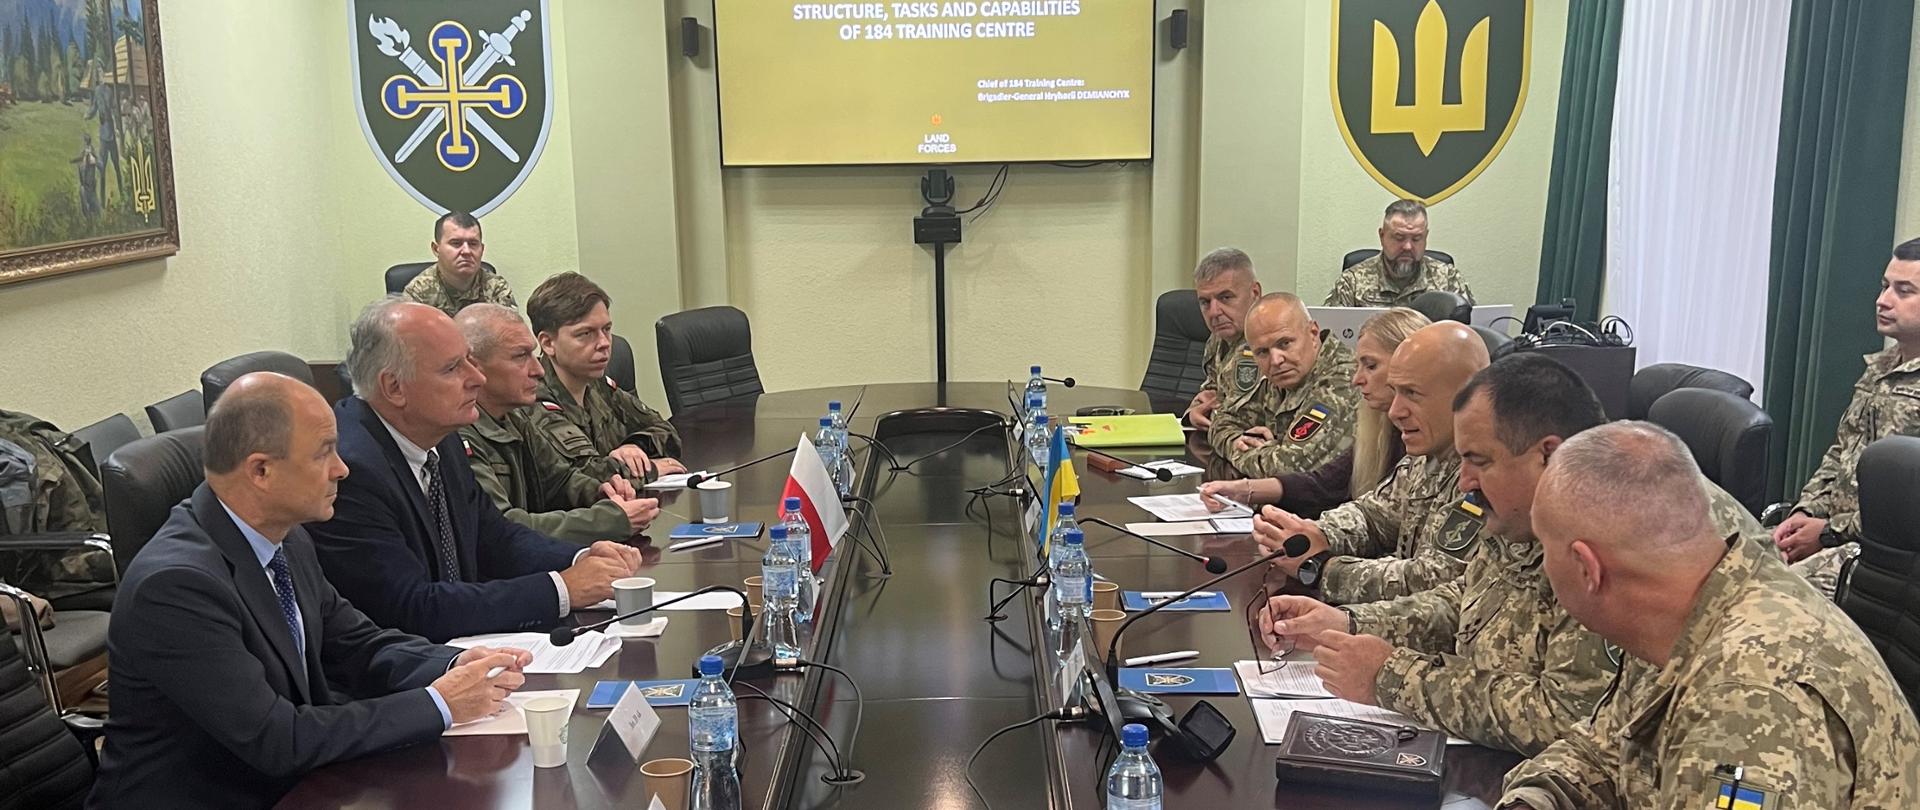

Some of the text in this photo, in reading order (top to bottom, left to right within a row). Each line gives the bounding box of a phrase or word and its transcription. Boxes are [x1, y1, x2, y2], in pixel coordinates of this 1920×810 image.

[793, 0, 1080, 21] STRUCTURE, TASKS AND CAPABILITIES
[840, 22, 1035, 40] OF 184 TRAINING CENTRE
[977, 79, 998, 88] Chief
[999, 79, 1008, 88] of
[1009, 79, 1023, 88] 184
[1024, 78, 1055, 88] Training
[977, 92, 1043, 102] Brigadier-General
[924, 133, 950, 143] LAND
[918, 144, 957, 153] FORCES
